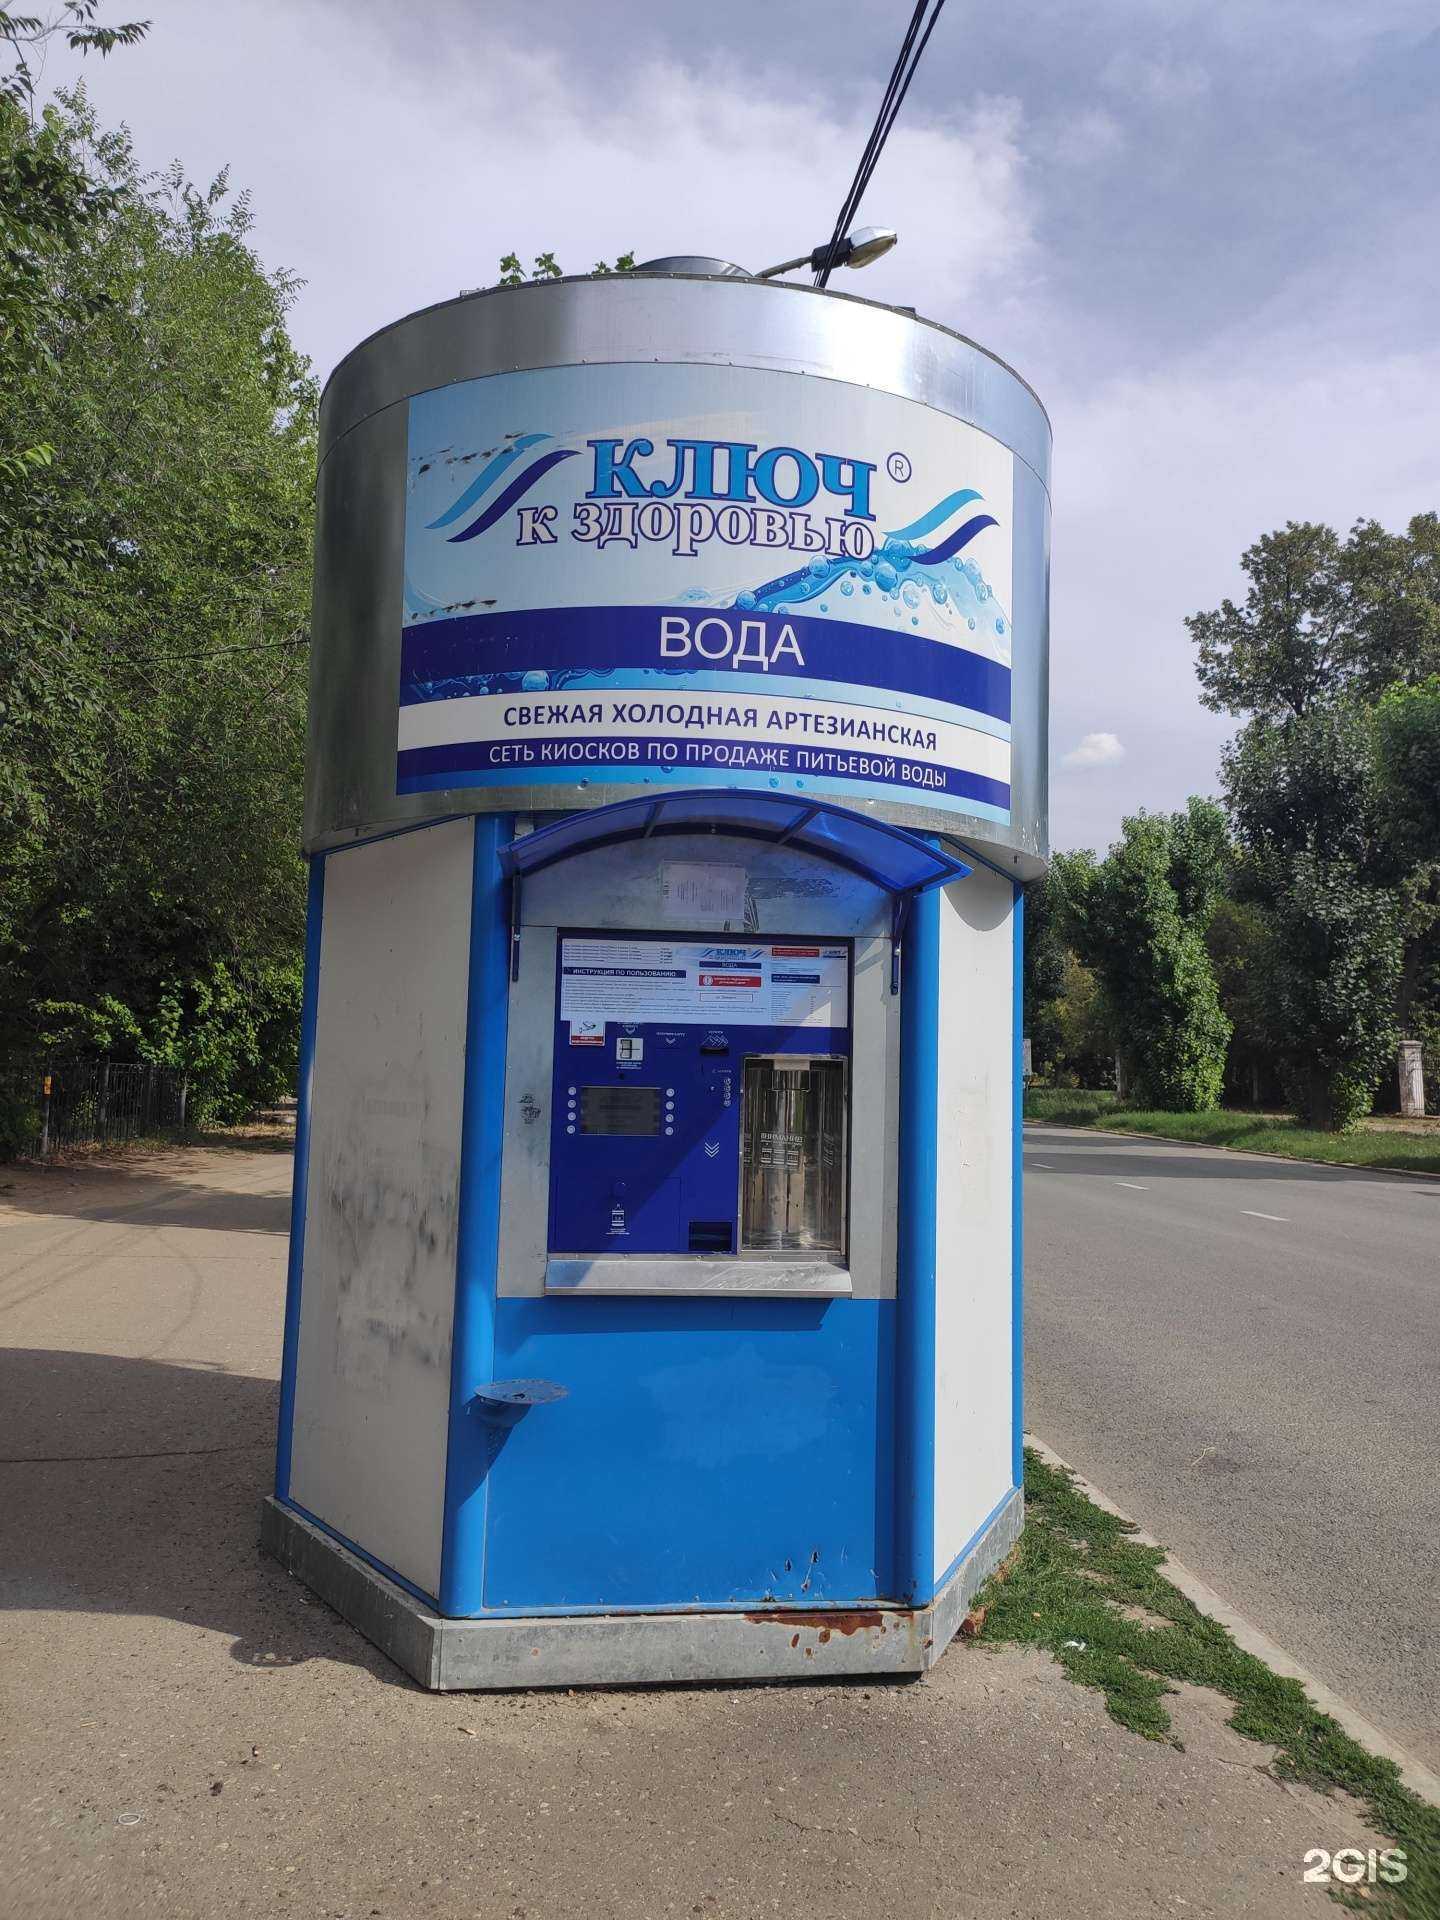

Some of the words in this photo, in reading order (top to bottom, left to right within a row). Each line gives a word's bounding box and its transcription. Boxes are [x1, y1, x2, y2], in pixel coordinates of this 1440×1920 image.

[660, 616, 805, 672] ВОДА
[503, 703, 603, 727] СВЕЖАЯ
[612, 703, 758, 730] ХОЛОДНАЯ
[766, 710, 937, 752] АРТЕЗИАНСКАЯ
[489, 744, 535, 763] СЕТЬ
[541, 742, 640, 761] КИОСКОВ
[647, 742, 678, 761] ПО
[686, 743, 789, 767] ПРОДАЖЕ
[796, 751, 896, 778] ПИТЬЕВОЙ
[901, 764, 946, 788] ВОДЫ
[572, 968, 615, 976] ИНСТРУКЦИЯ
